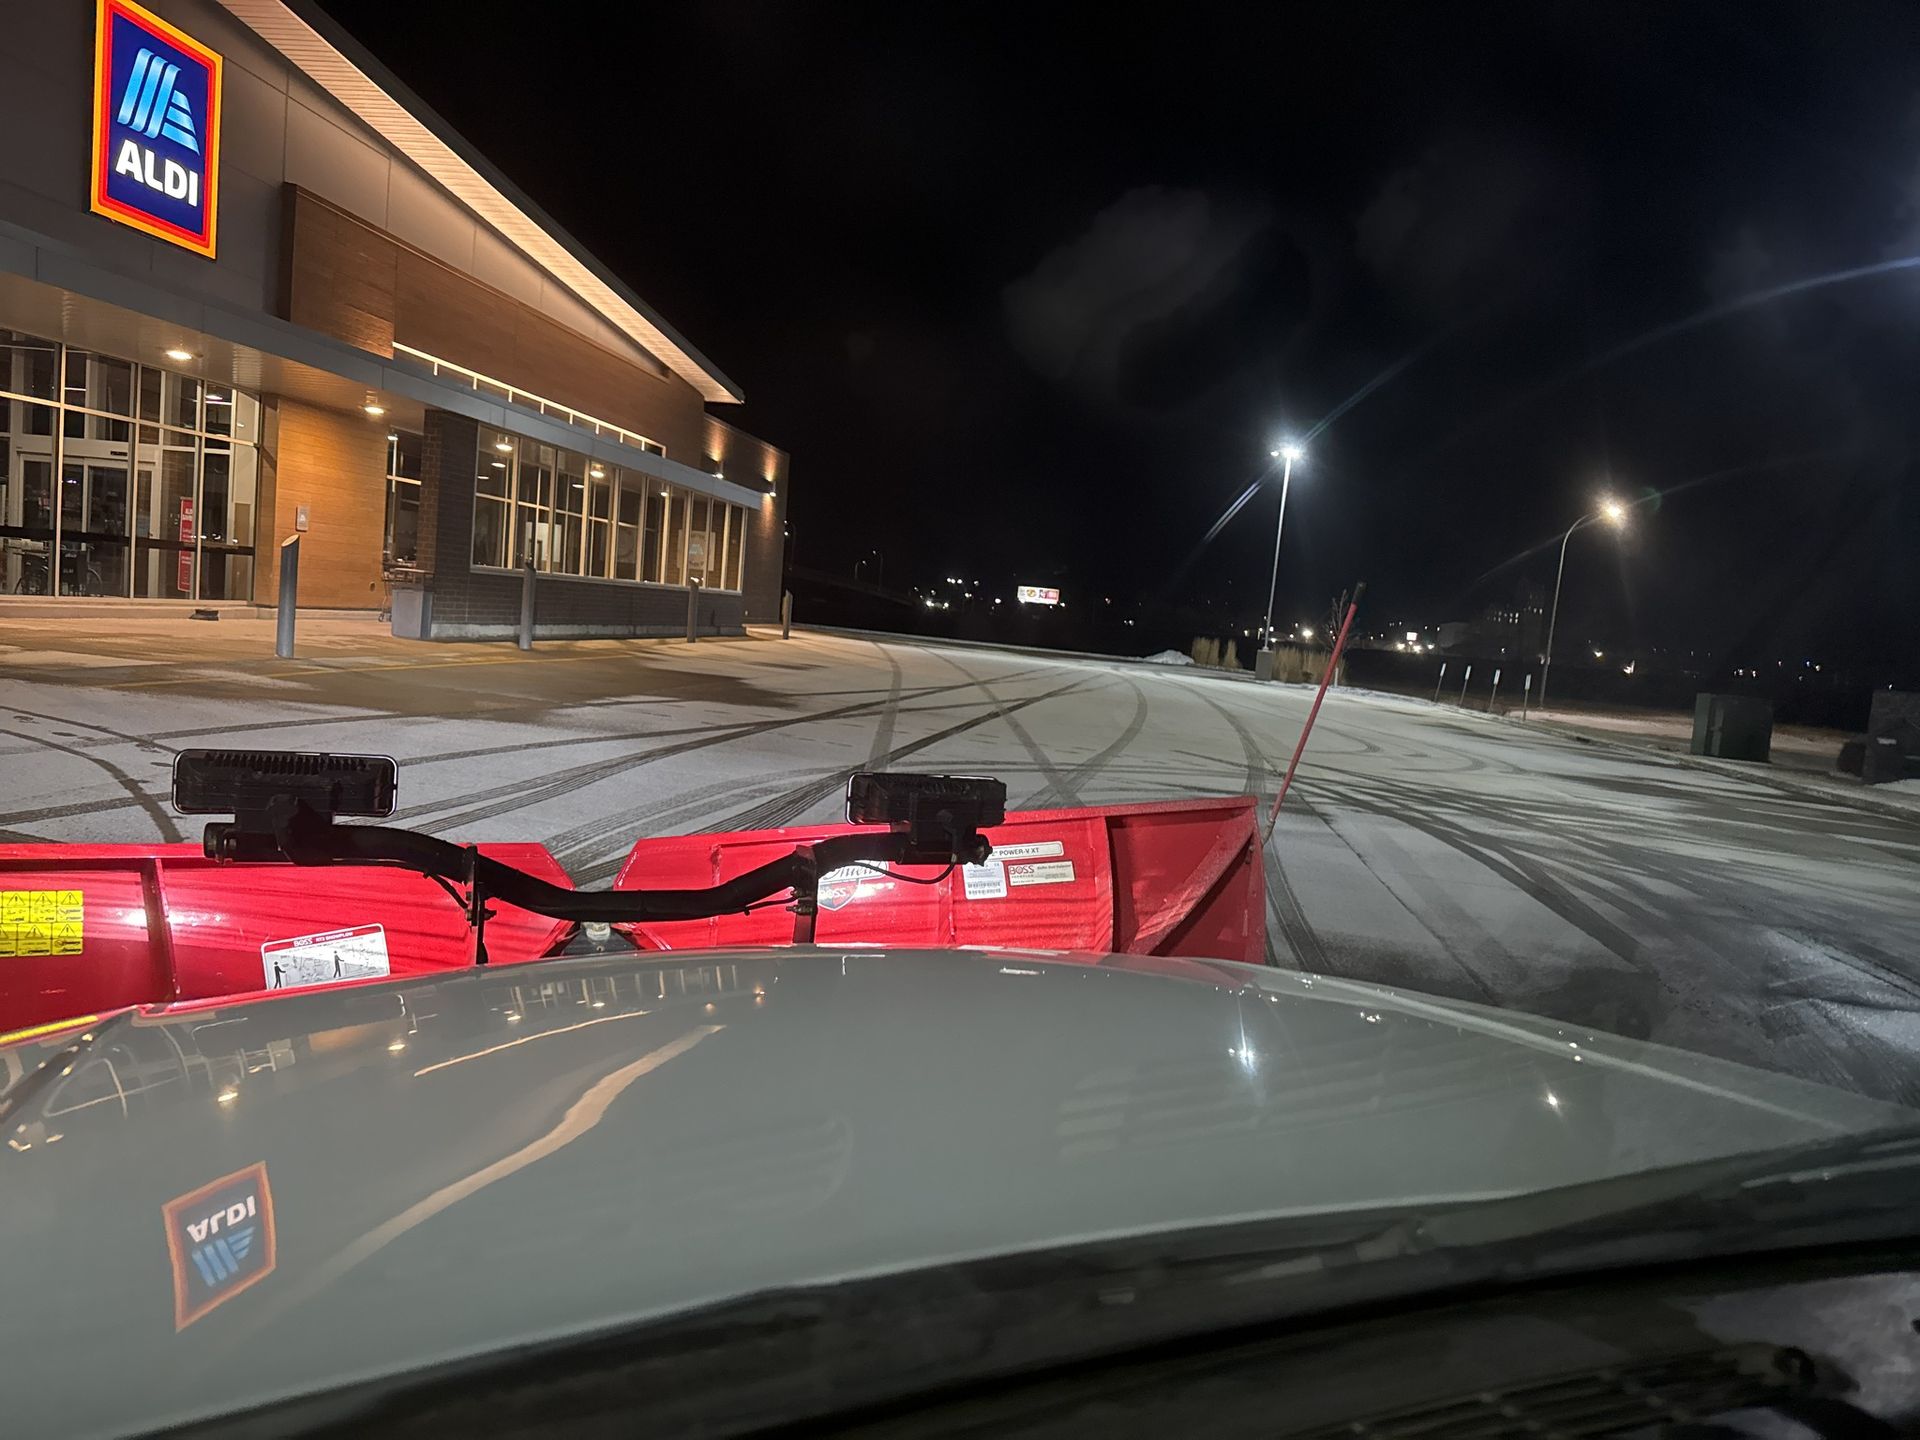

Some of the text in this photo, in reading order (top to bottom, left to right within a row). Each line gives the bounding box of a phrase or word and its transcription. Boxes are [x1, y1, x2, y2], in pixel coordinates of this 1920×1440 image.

[115, 139, 198, 207] ALDI
[999, 848, 1030, 856] POWER-V
[1009, 865, 1034, 874] BOSS
[293, 938, 313, 947] BOSS
